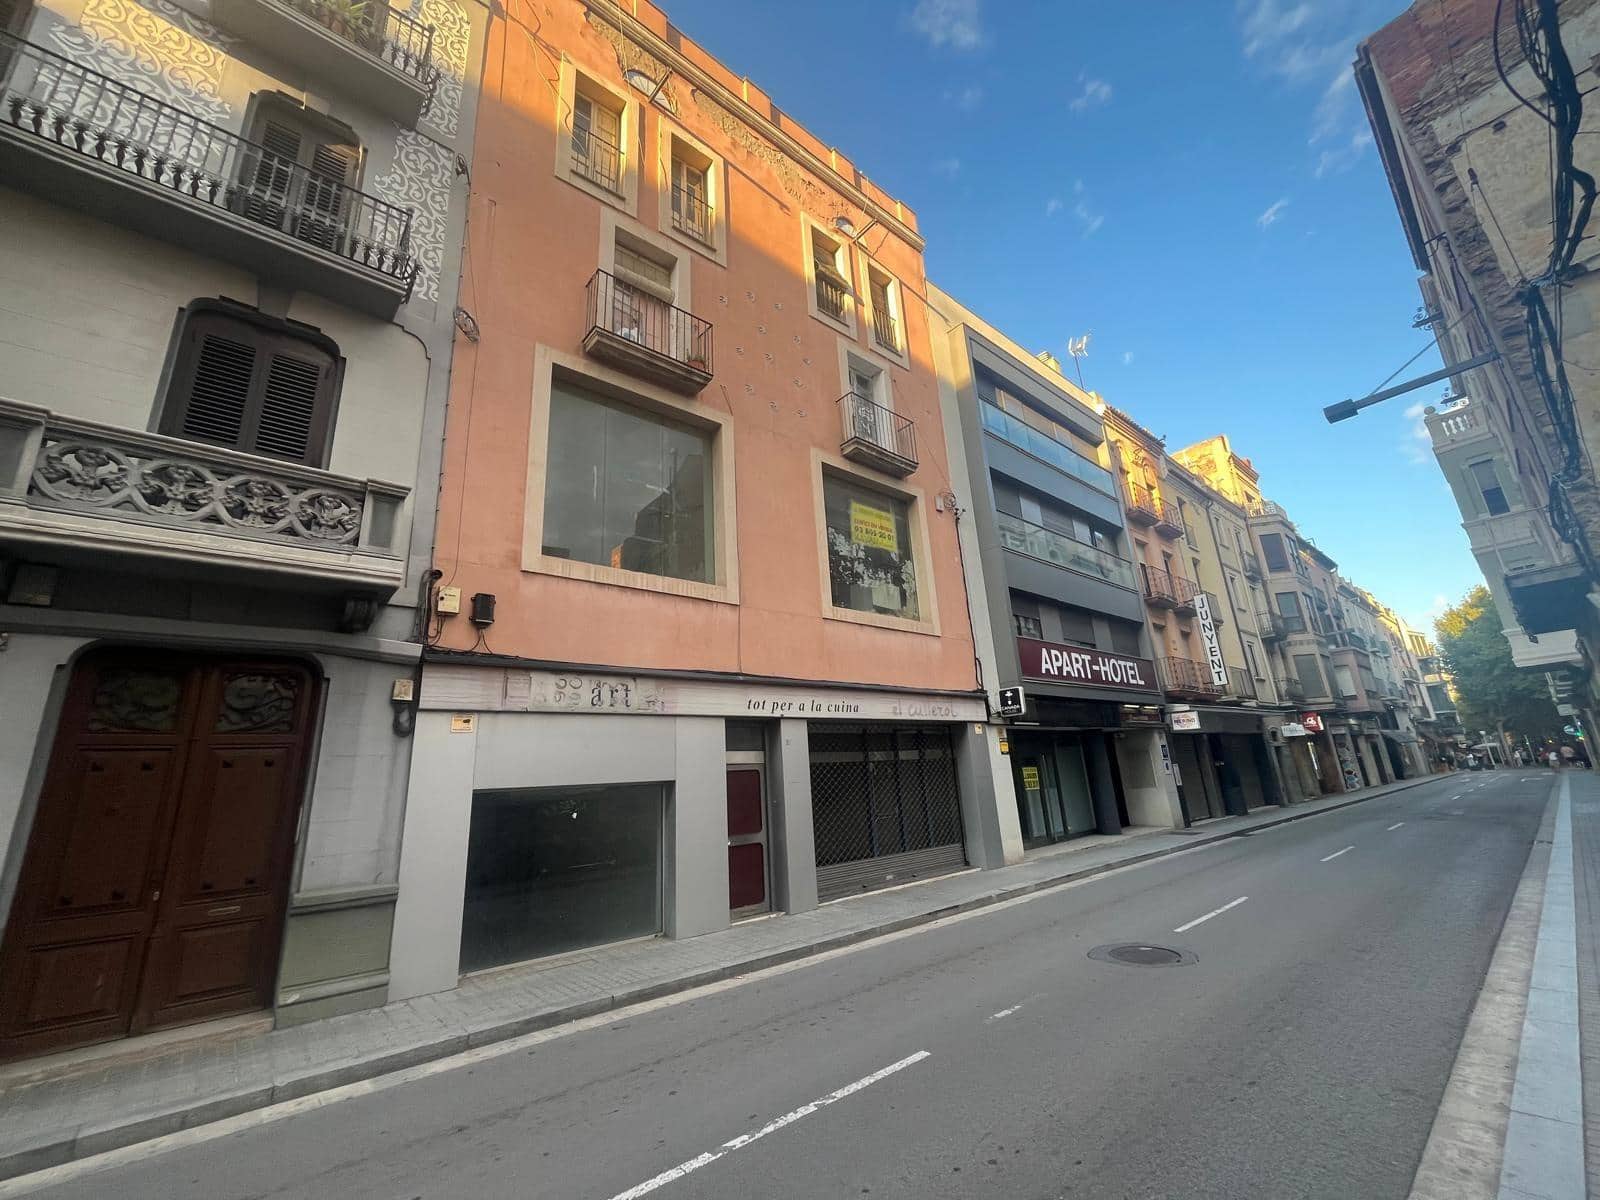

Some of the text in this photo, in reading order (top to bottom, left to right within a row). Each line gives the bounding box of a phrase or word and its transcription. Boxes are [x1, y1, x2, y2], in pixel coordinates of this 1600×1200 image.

[1199, 598, 1223, 682] JUNYENT
[1041, 647, 1145, 685] APART-HOTEL
[747, 699, 860, 714] tot per a la cuina
